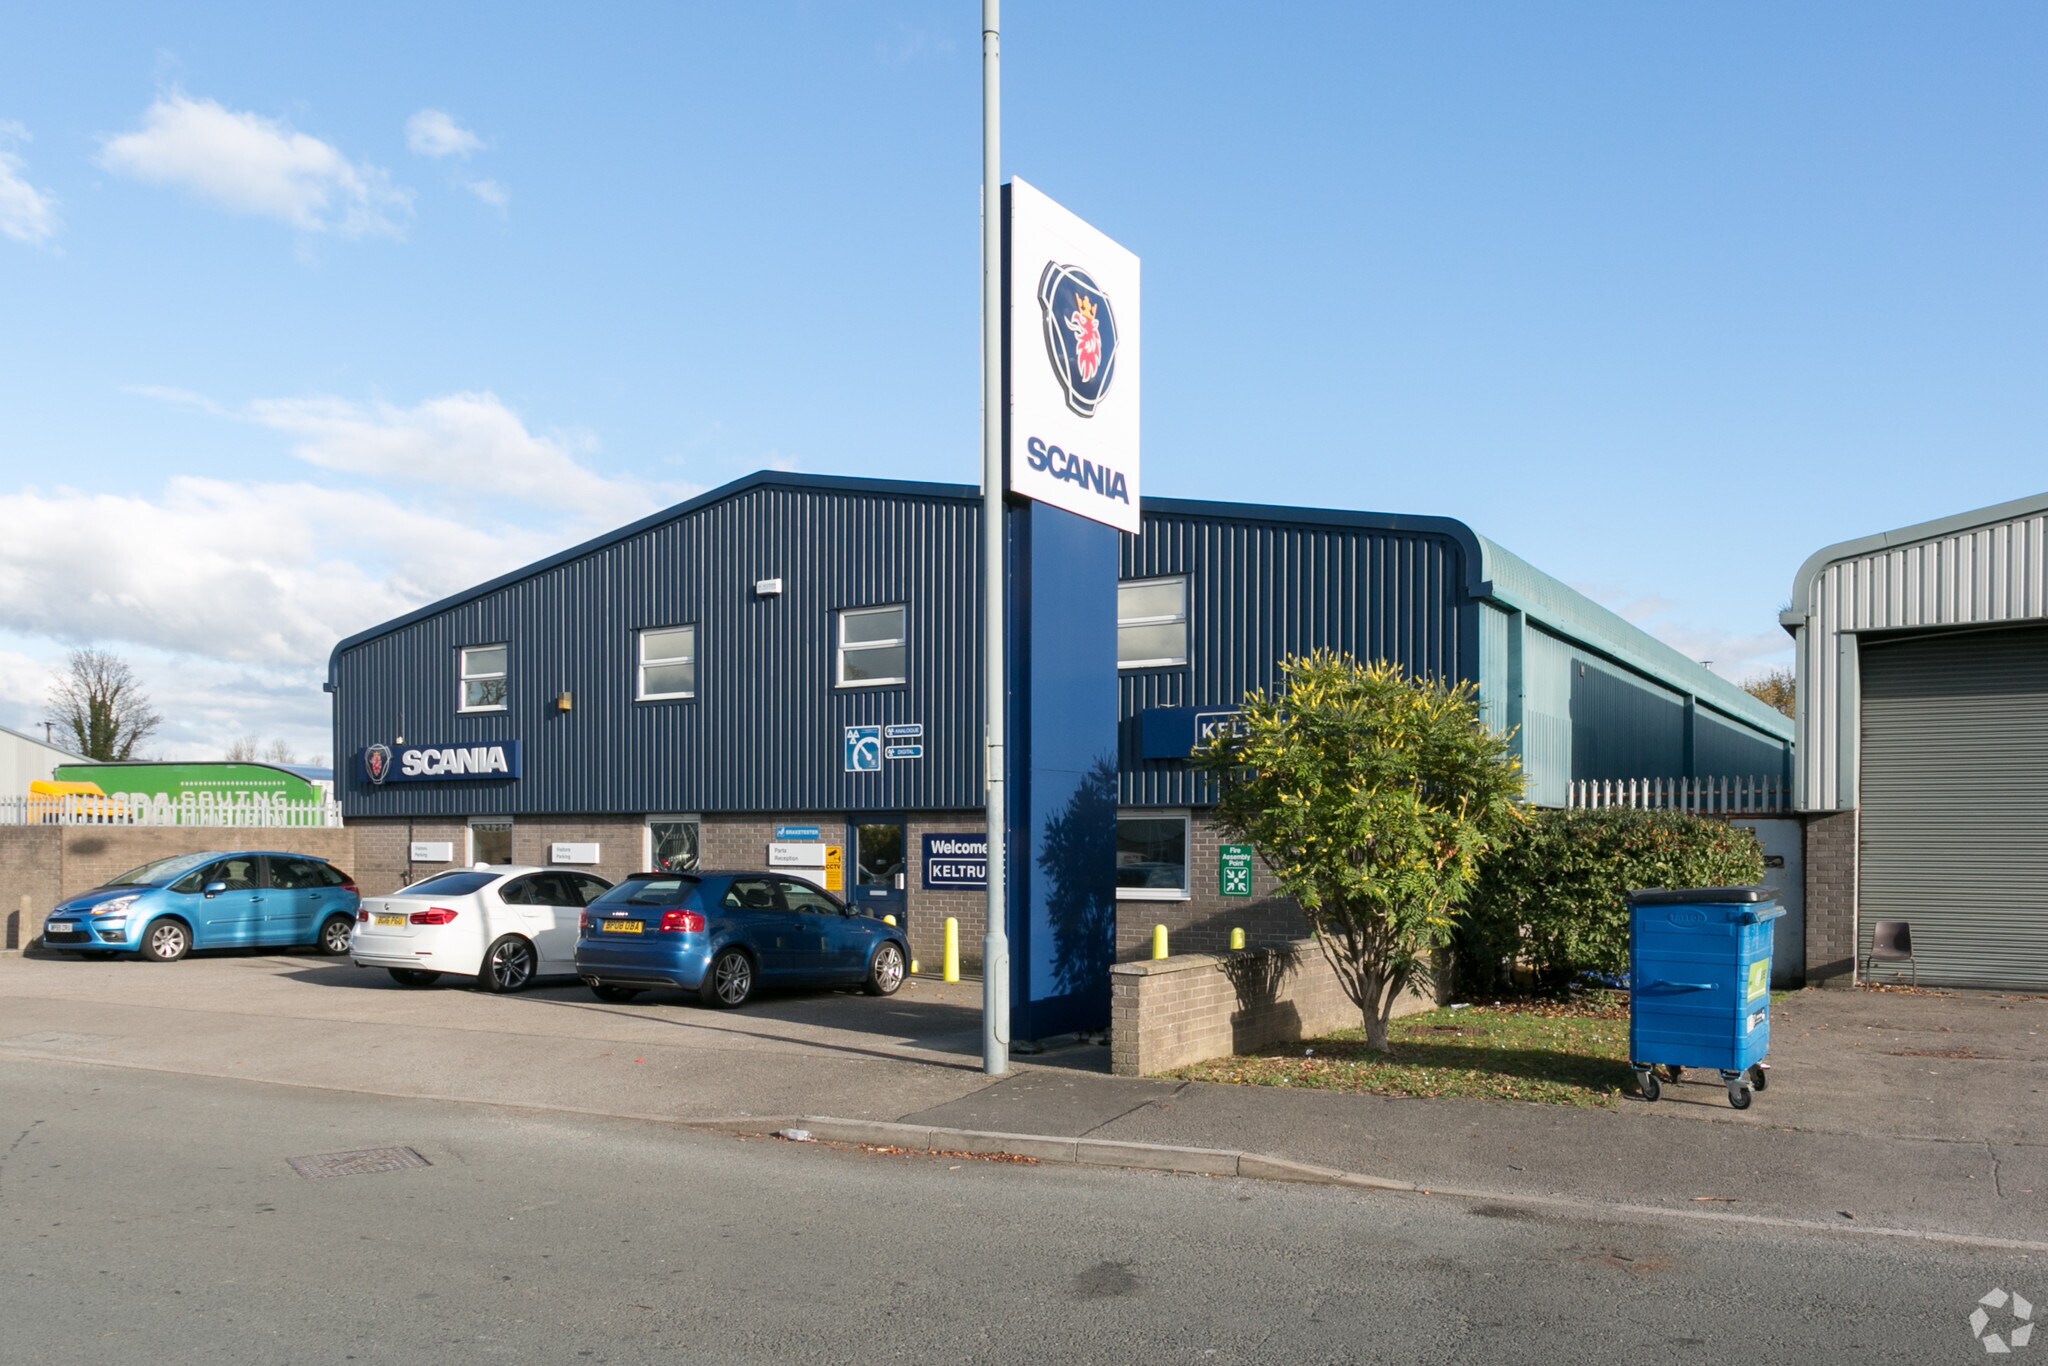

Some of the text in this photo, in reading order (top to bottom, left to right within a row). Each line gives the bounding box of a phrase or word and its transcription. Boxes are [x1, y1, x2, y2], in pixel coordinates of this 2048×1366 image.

[1027, 436, 1130, 506] SCANIA
[402, 746, 508, 776] SCANIA
[931, 839, 987, 854] Welcome
[1222, 853, 1251, 861] Assembly
[933, 864, 986, 878] KELTRU
